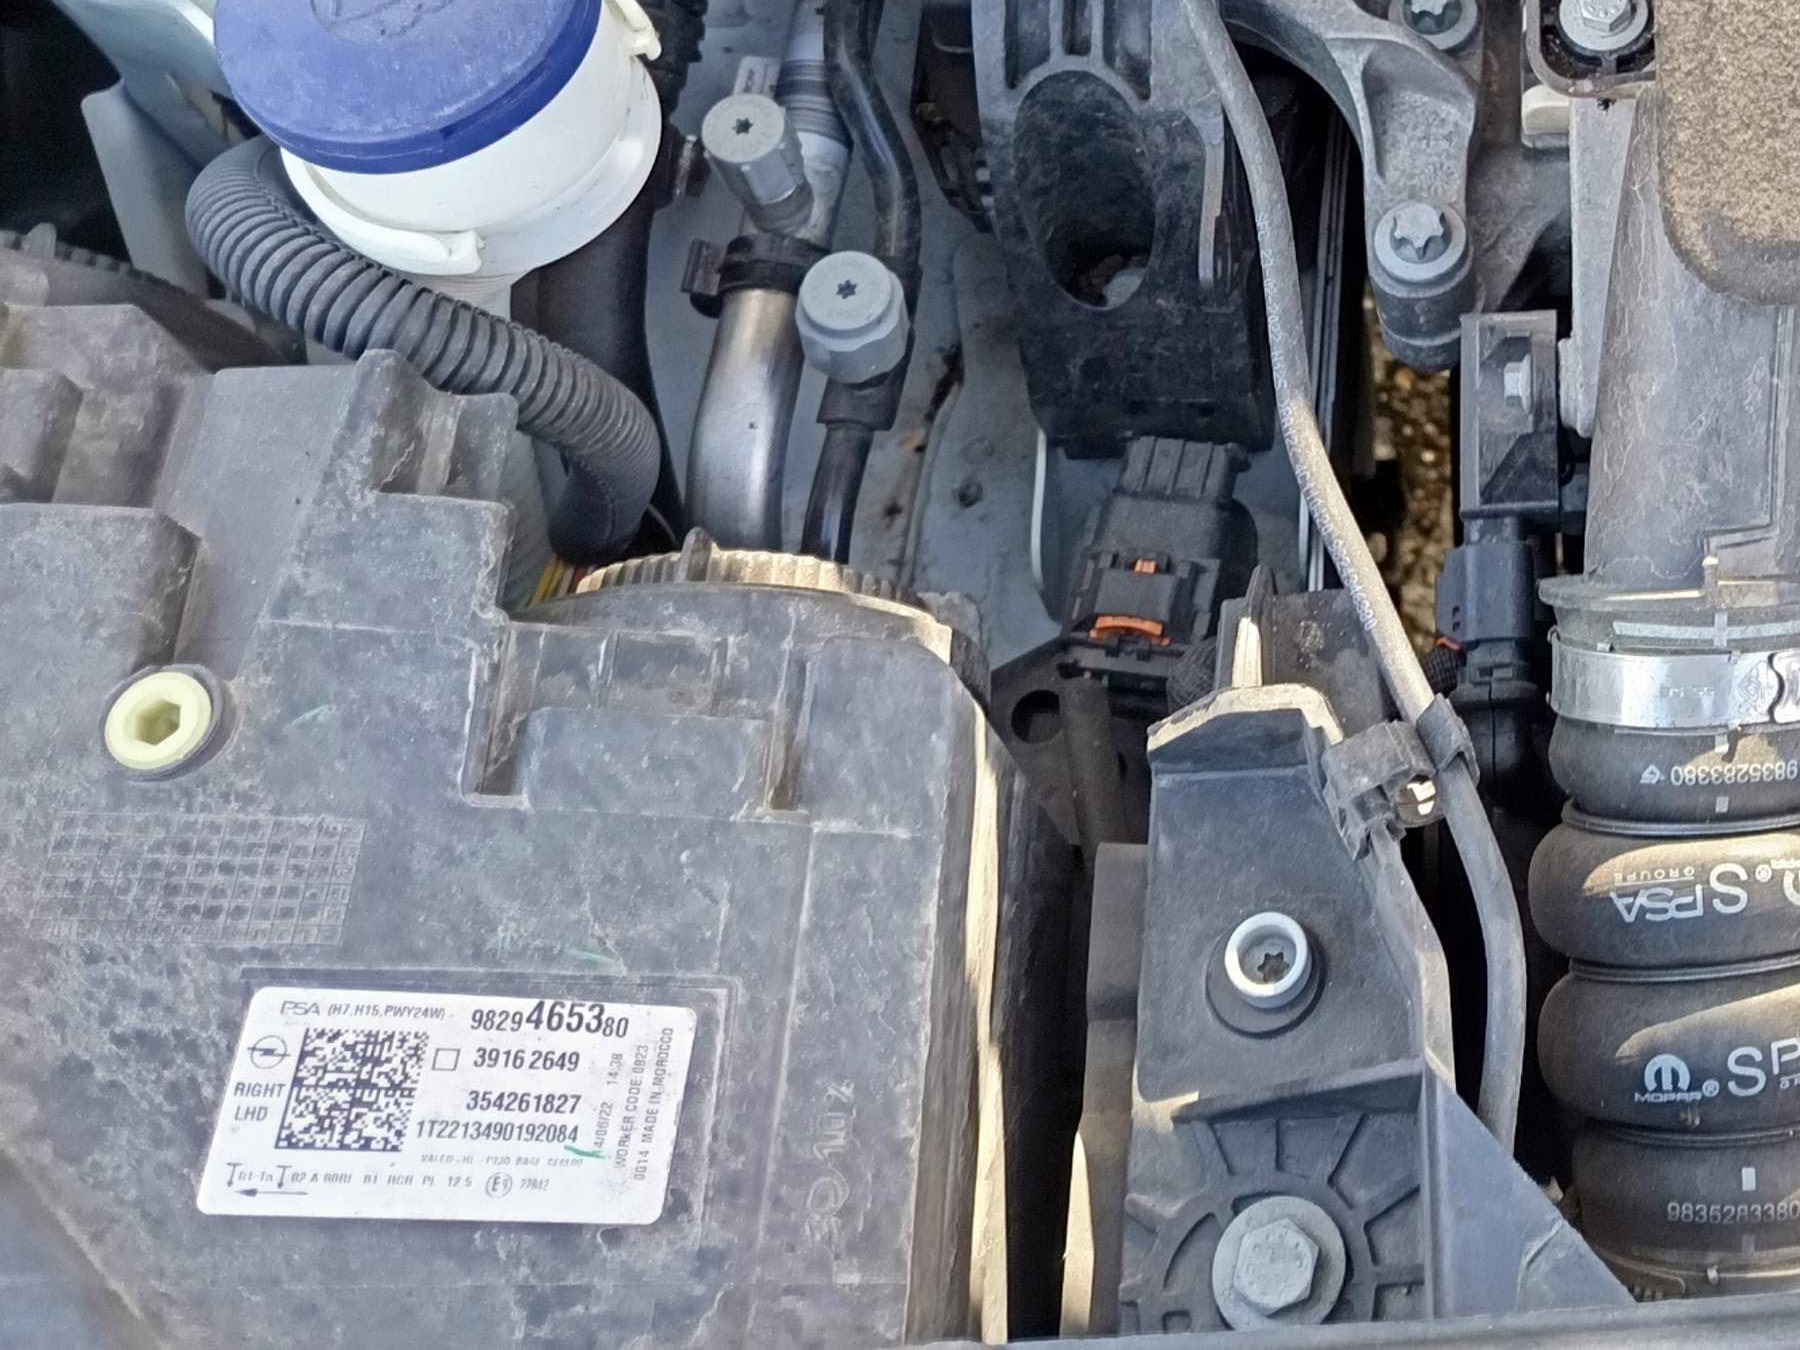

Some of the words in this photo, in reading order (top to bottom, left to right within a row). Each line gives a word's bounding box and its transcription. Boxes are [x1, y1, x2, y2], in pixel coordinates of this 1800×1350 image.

[1670, 759, 1799, 786] 9835283380
[1613, 865, 1696, 882] GROUPE
[1709, 862, 1749, 915] S
[1609, 883, 1704, 923] PSA
[280, 1000, 321, 1016] PSA
[1727, 1046, 1767, 1097] S
[233, 1081, 287, 1098] RIGHT
[465, 1089, 582, 1115] 354261827
[1634, 1091, 1702, 1103] MOPAR
[233, 1105, 268, 1122] LHD
[641, 1106, 660, 1144] MADE
[416, 1119, 579, 1144] 1T2213490192084
